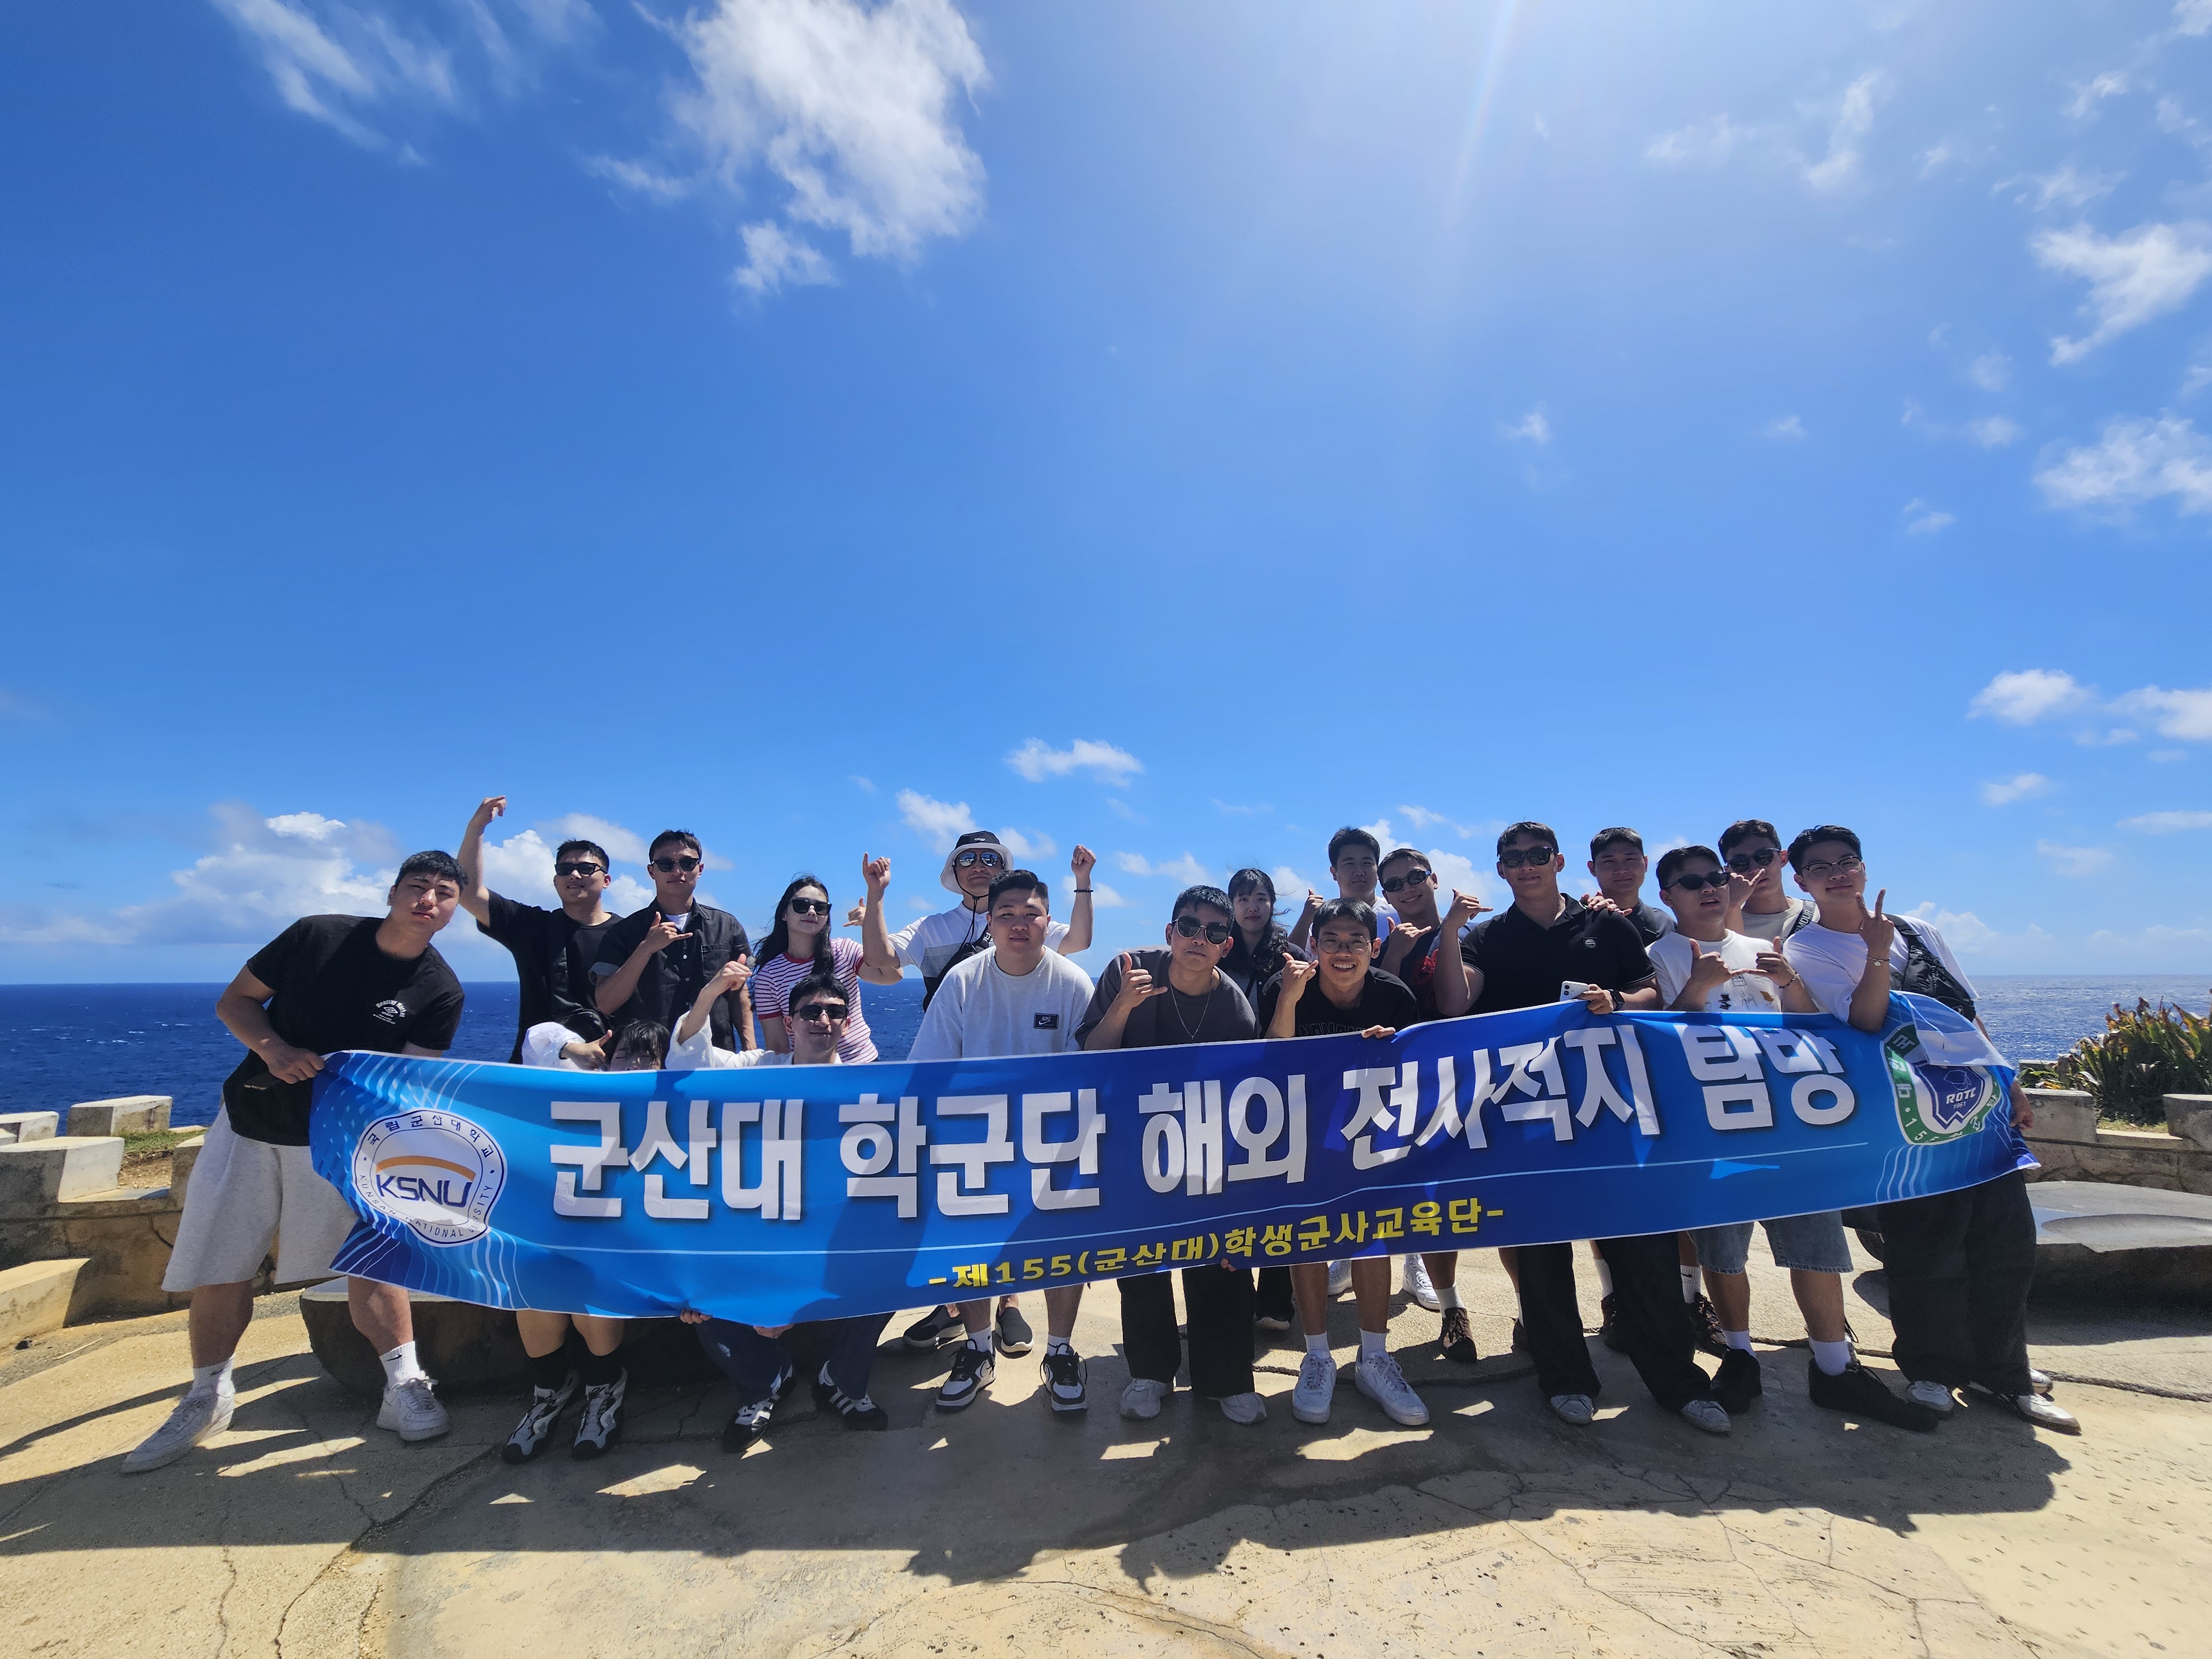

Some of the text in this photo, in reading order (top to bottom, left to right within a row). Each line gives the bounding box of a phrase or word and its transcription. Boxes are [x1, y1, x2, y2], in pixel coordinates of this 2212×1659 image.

[1946, 1087, 1976, 1104] ROTC
[367, 1115, 493, 1159] 국립군산대학교
[550, 1025, 1855, 1220] 군산대 학군단 해외 전사적지 탐방
[359, 1174, 397, 1215] KUNSAN
[405, 1217, 464, 1238] NATIONAL
[375, 1174, 473, 1208] KSNU
